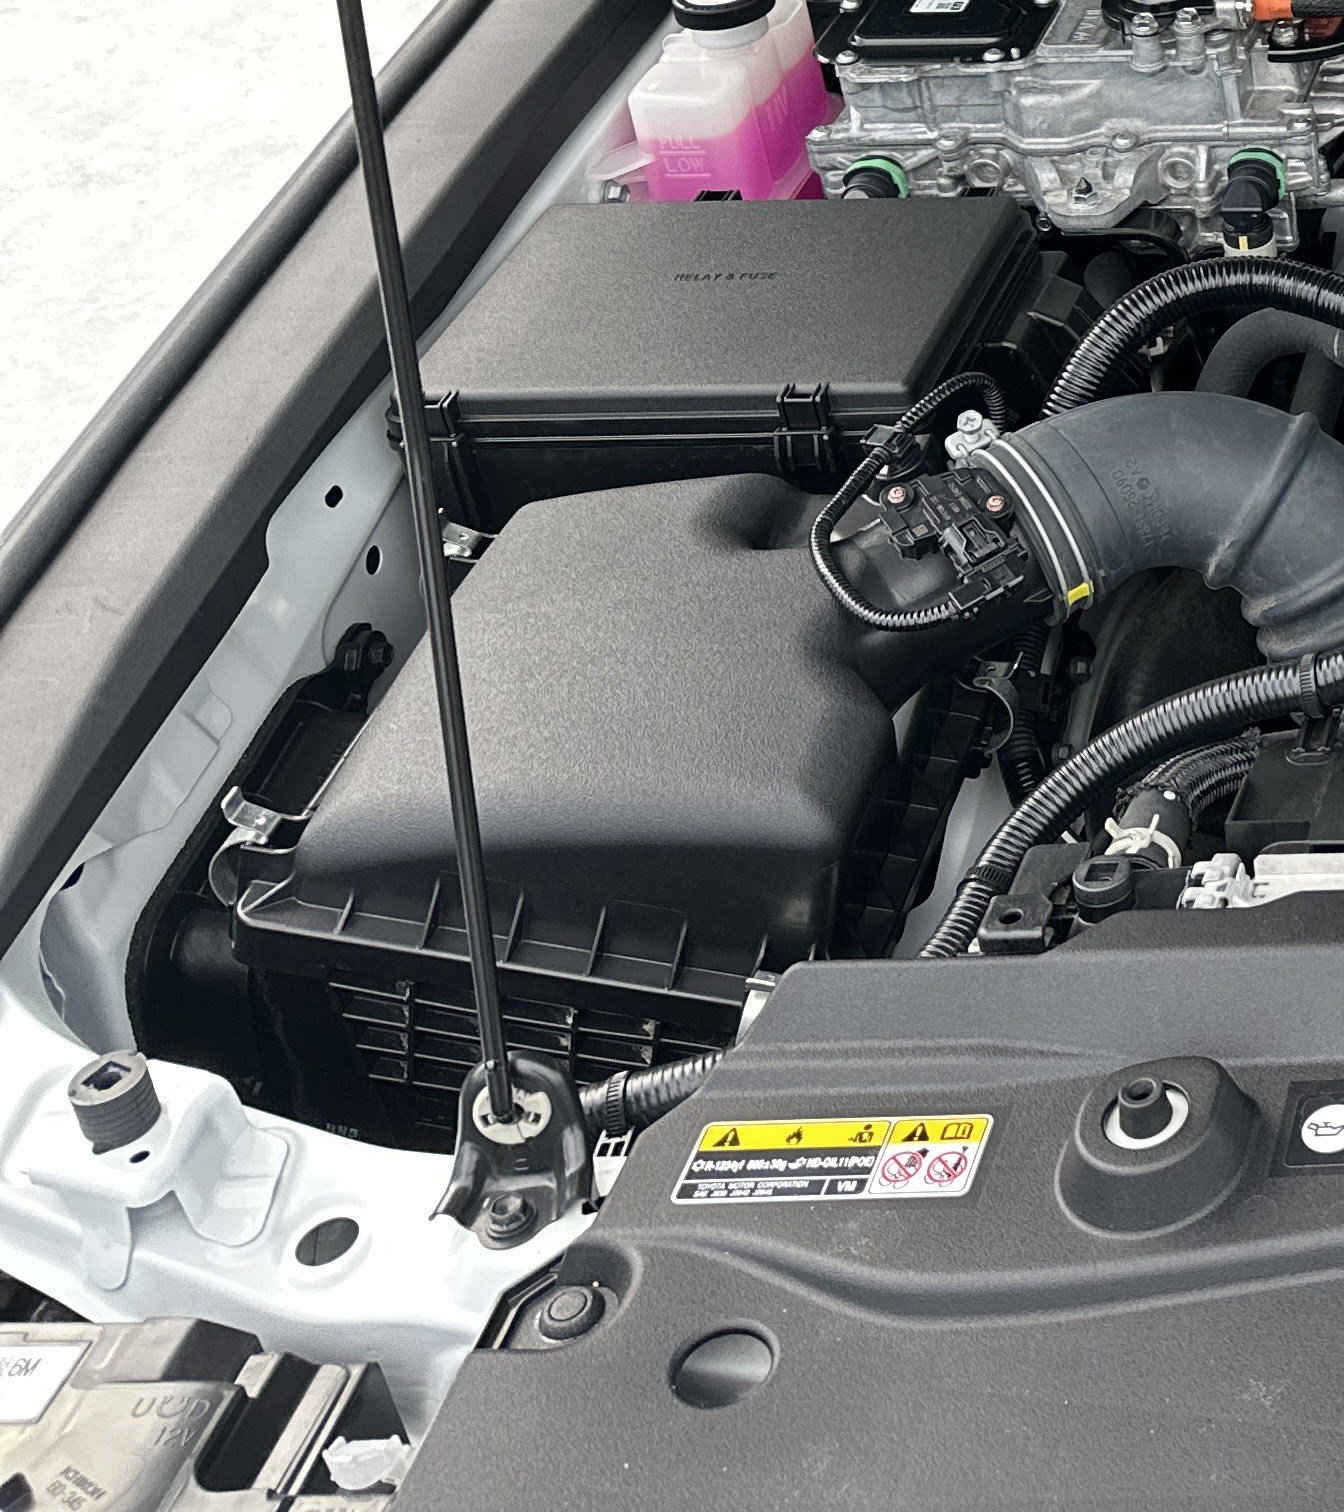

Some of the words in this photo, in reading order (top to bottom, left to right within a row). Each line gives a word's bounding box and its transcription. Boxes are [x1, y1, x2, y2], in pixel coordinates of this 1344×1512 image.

[660, 136, 702, 150] FULL
[664, 156, 705, 174] LOW
[672, 272, 723, 282] RELAY
[738, 271, 779, 281] FUSE
[697, 1181, 726, 1190] TOYOTA
[154, 1426, 198, 1447] 12V
